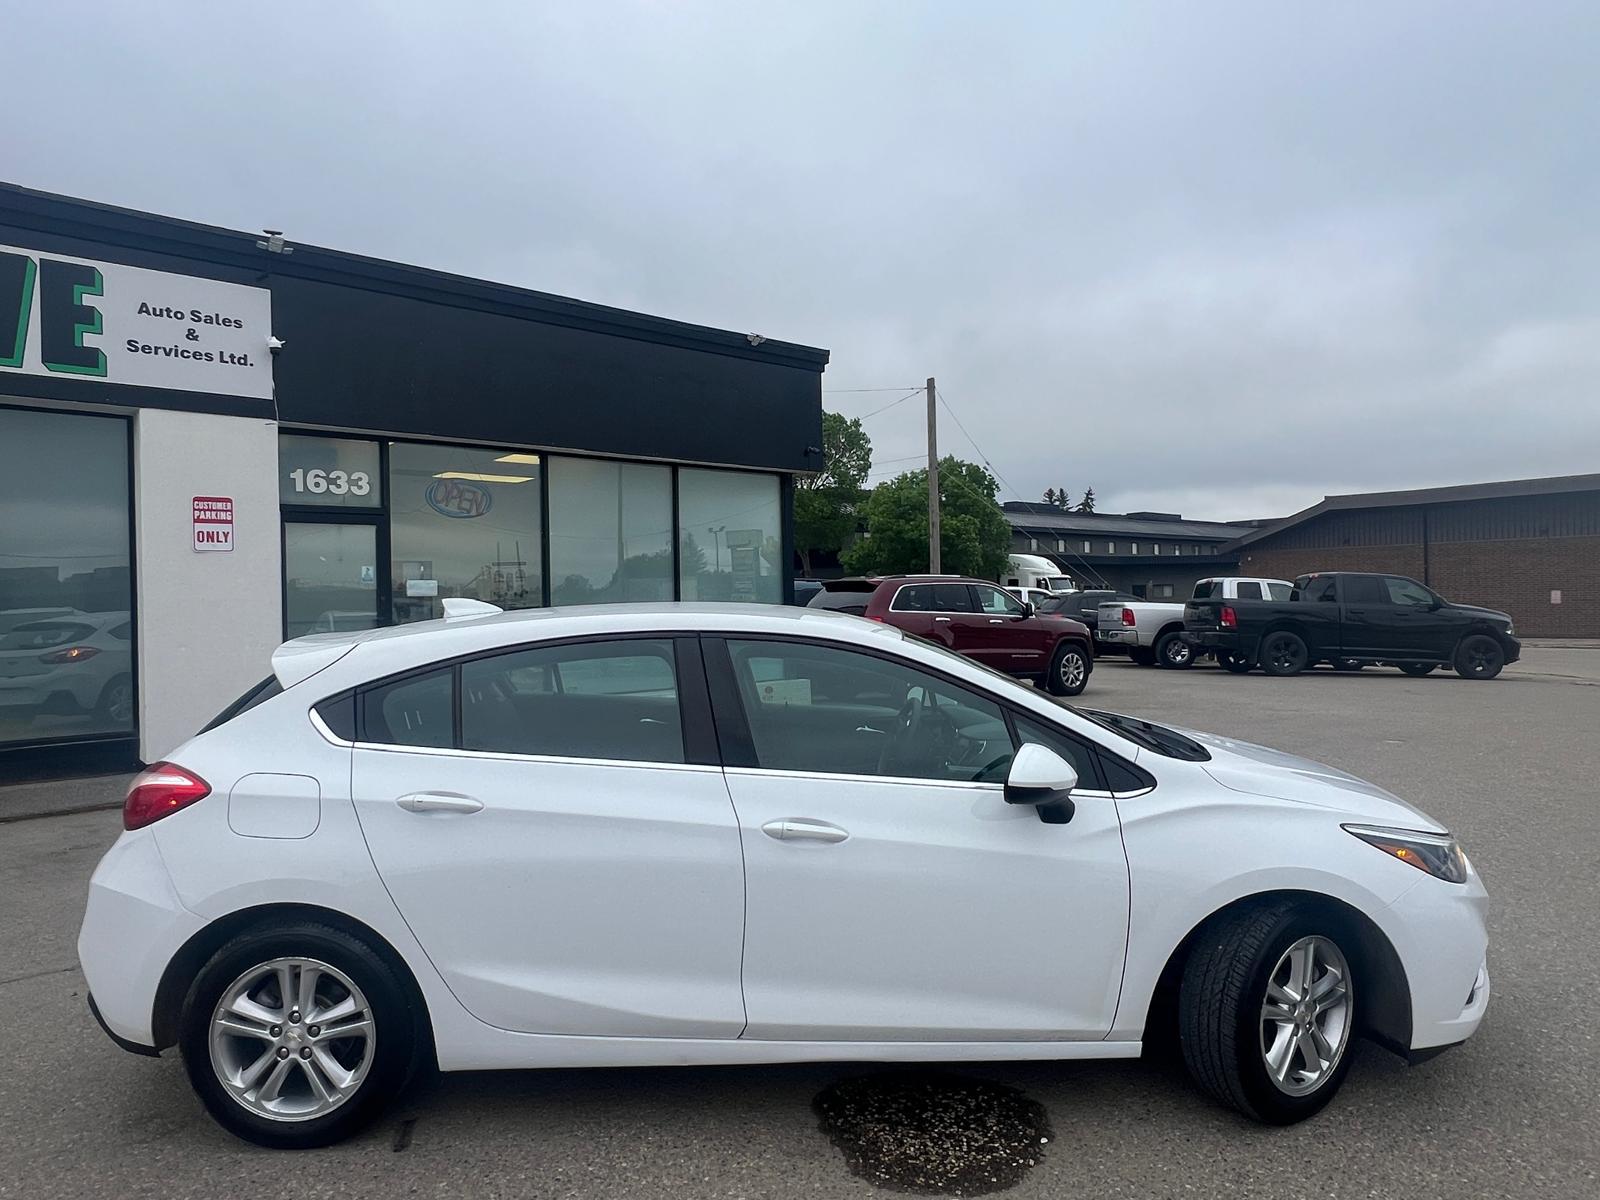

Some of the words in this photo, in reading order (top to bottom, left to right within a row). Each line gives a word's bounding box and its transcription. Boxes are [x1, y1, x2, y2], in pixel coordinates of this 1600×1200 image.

[138, 302, 185, 321] Auto
[190, 309, 243, 329] Sales
[185, 328, 200, 341] &
[126, 339, 214, 362] Services
[219, 351, 254, 367] Ltd.
[290, 468, 370, 496] 1633
[194, 501, 232, 510] CUSTOMER
[434, 480, 486, 514] OPEN
[194, 510, 232, 520] PARKING
[197, 530, 230, 543] ONLY
